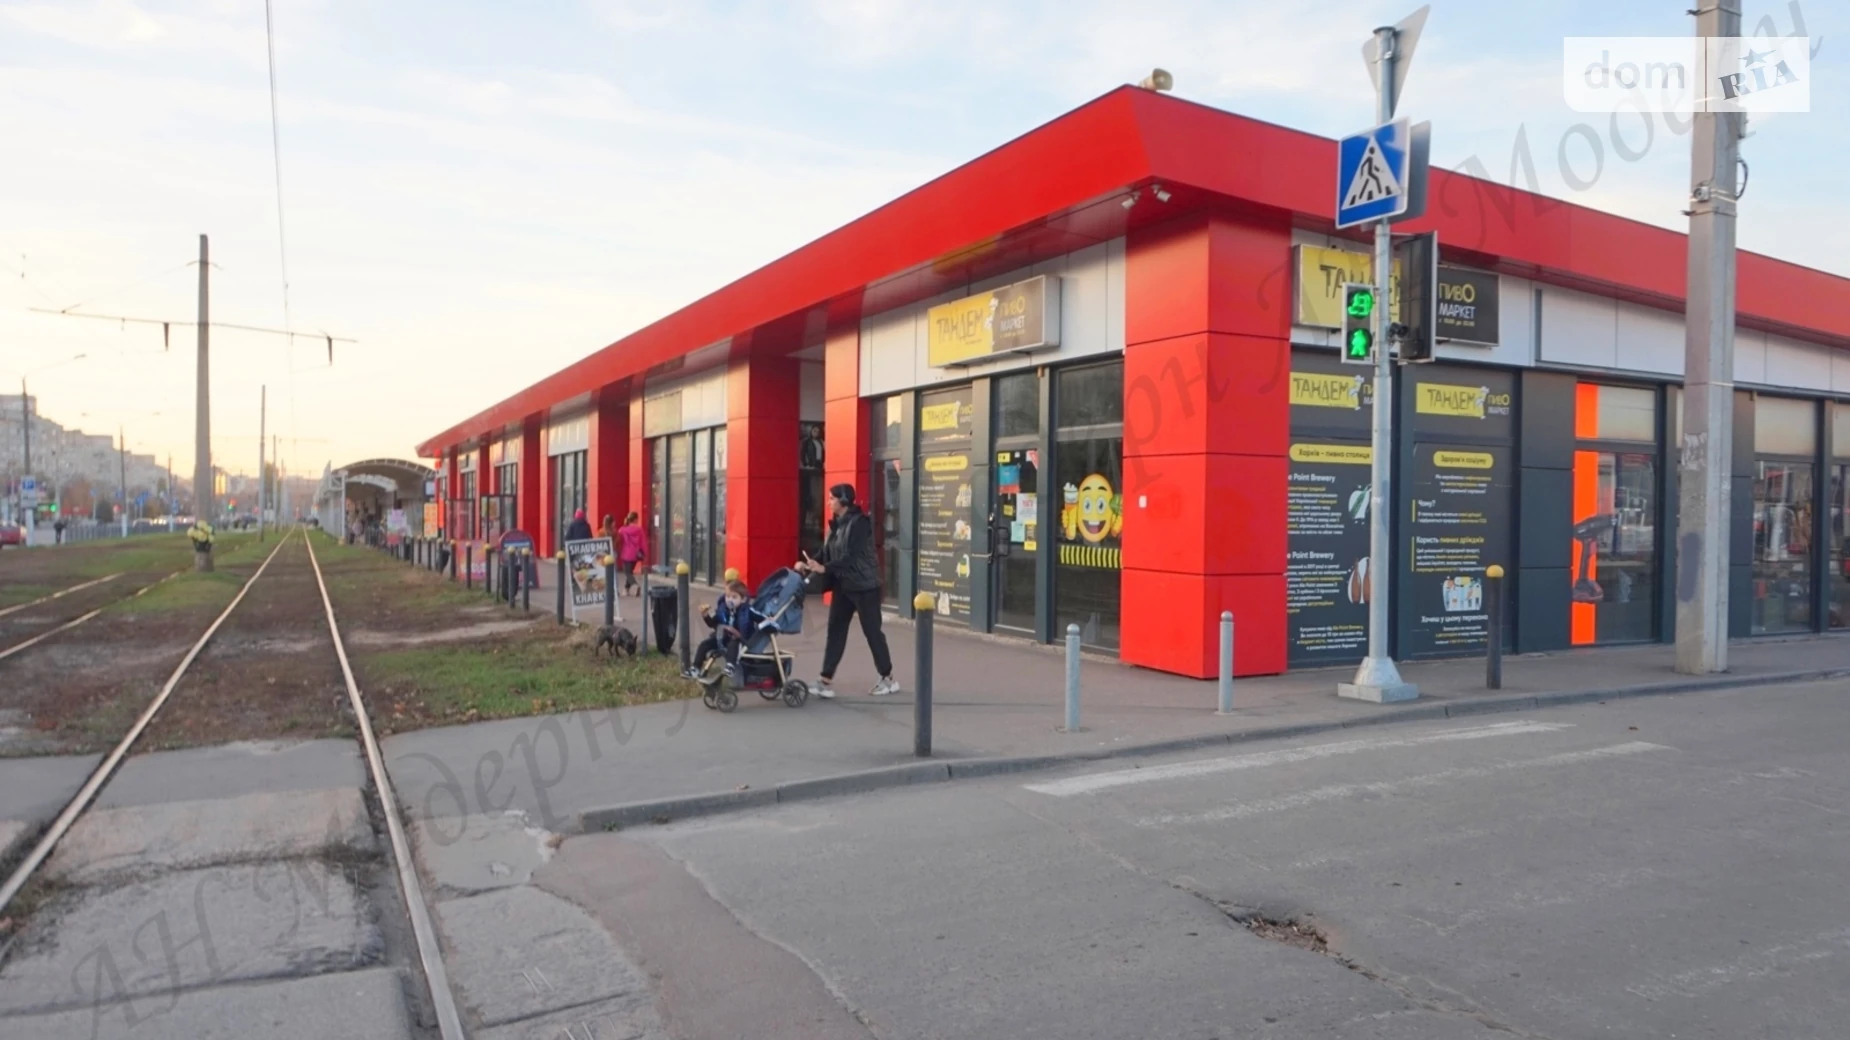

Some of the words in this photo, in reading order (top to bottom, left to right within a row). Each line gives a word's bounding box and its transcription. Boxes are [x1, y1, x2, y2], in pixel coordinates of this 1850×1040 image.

[1438, 303, 1476, 320] МАРКЕТ
[936, 308, 983, 344] ТАНДЕМ
[1000, 314, 1025, 331] МАРКЕТ
[1293, 377, 1350, 402] ТАНДЕМ
[1427, 388, 1477, 412] ТАНДЕМ
[1293, 473, 1310, 481] Point
[1292, 551, 1309, 559] Point
